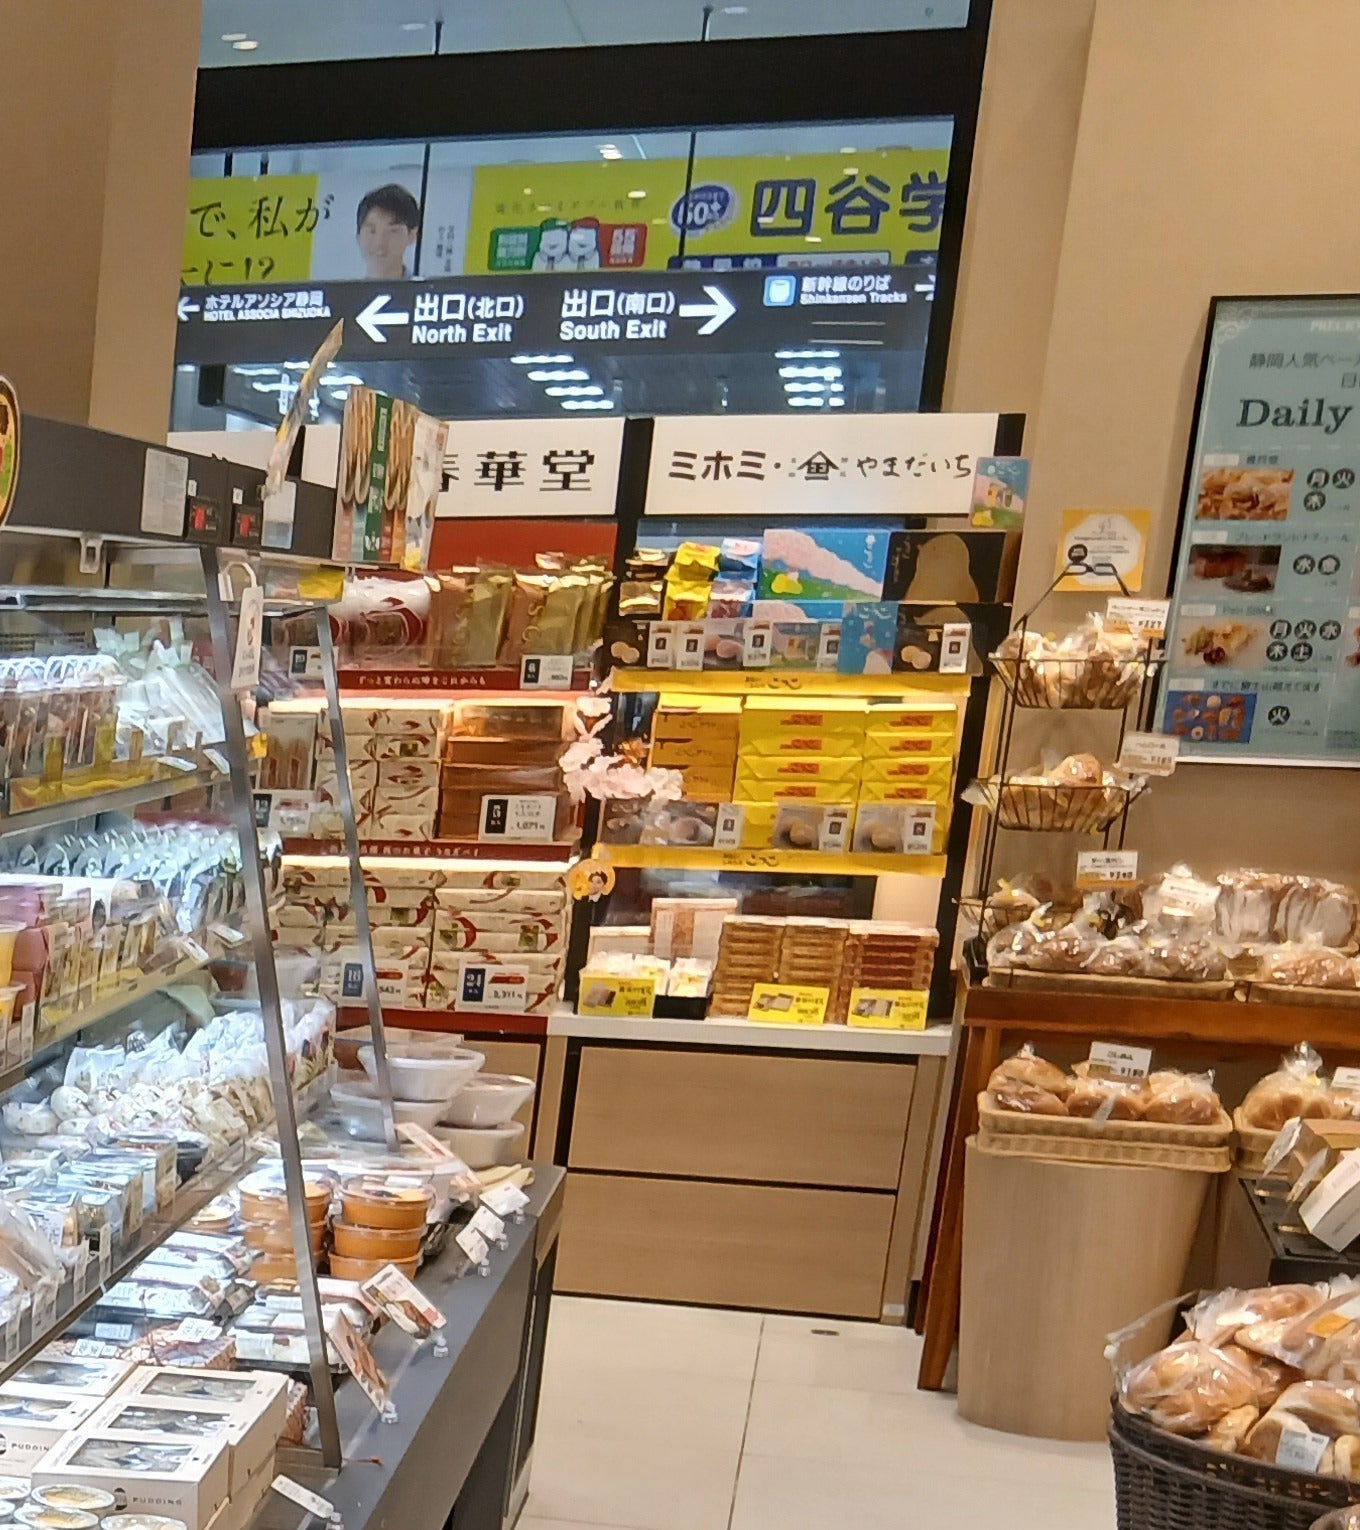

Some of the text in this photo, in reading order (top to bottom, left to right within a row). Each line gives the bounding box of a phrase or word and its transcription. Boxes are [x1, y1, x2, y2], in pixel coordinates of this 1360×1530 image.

[188, 195, 335, 242] で、私が
[801, 275, 892, 293] 新幹線のりば
[413, 293, 524, 323] 出口(北口)
[561, 288, 674, 318] 出口(南口)
[411, 322, 513, 343] North Exit
[559, 318, 668, 340] South Exit
[1235, 398, 1353, 435] Daily
[132, 1496, 183, 1507] PUDDING
